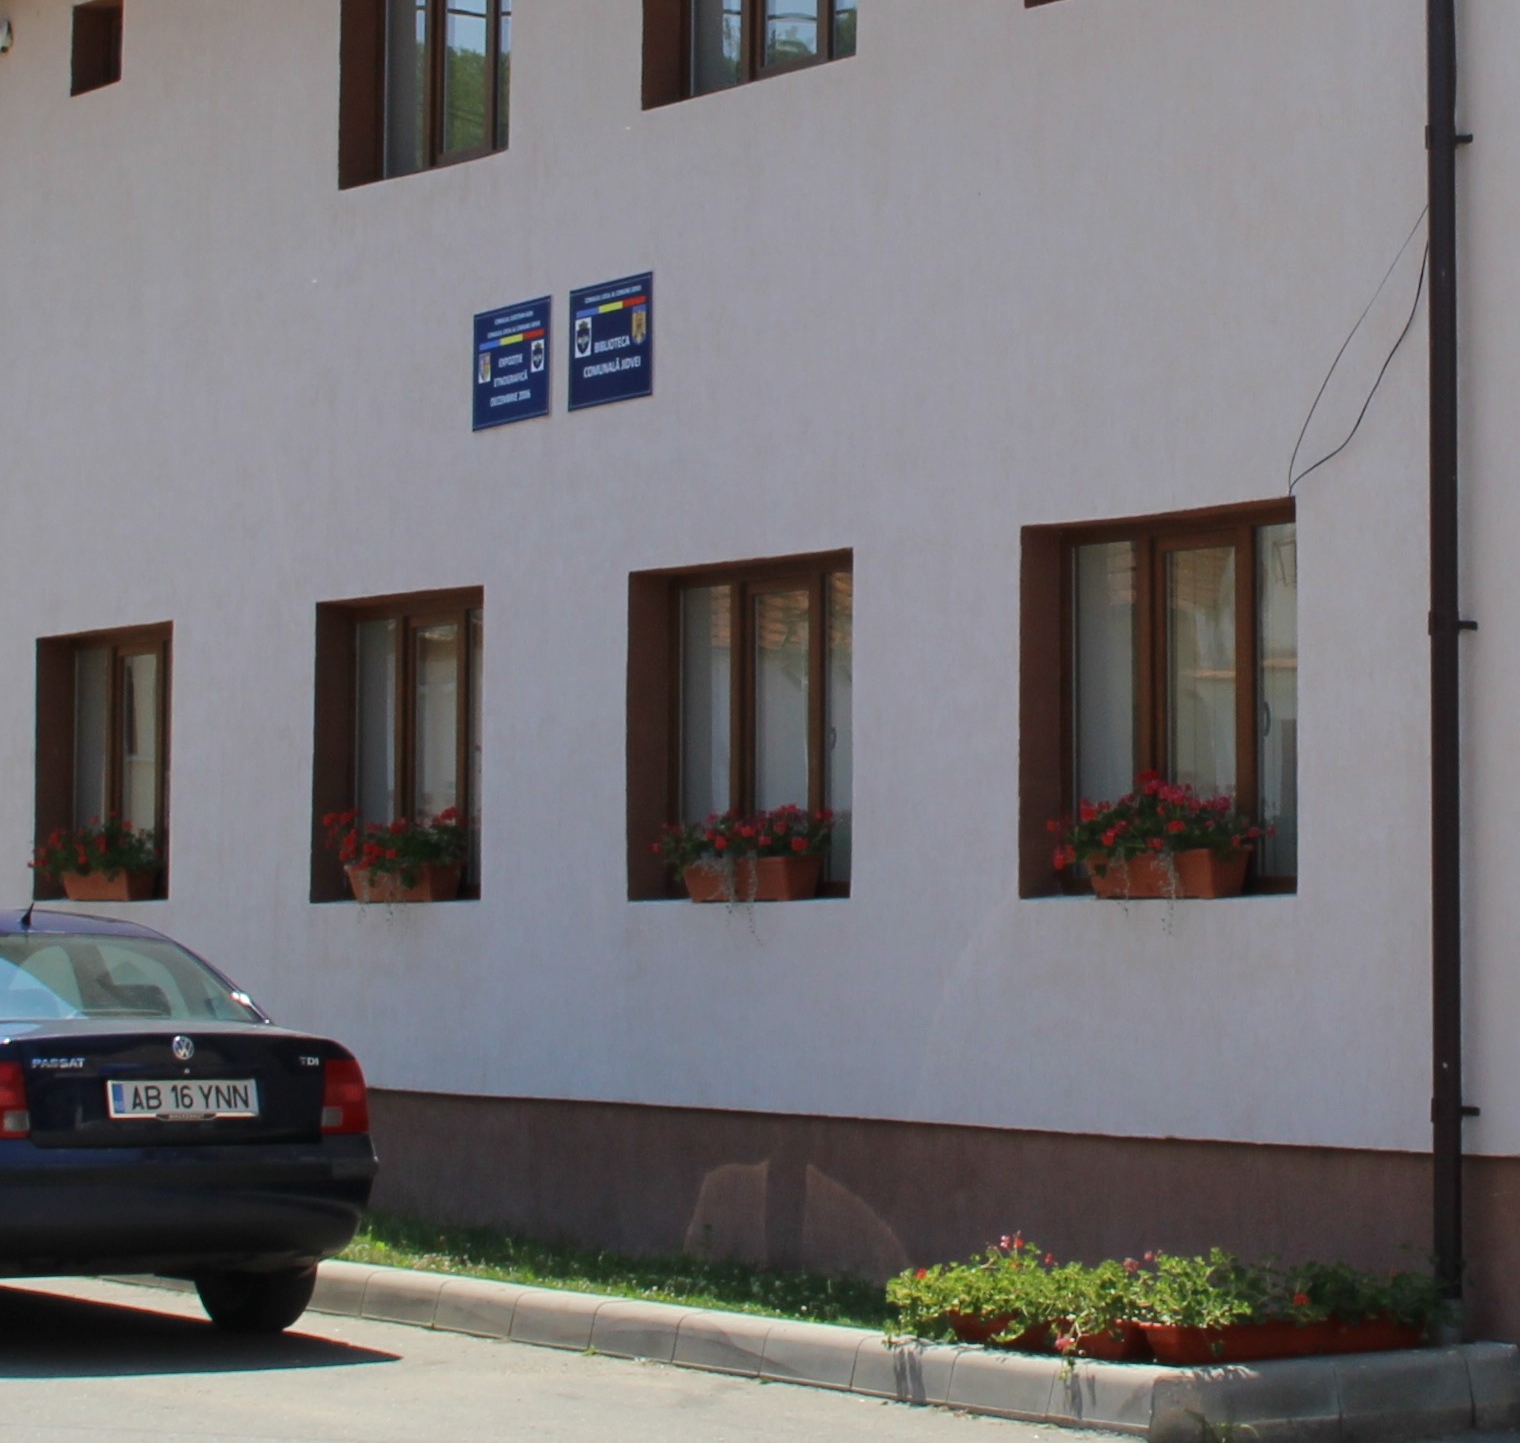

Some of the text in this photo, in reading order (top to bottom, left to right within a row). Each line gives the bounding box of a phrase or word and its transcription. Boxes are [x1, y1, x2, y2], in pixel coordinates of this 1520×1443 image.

[594, 335, 630, 353] BIBLIOTECA
[583, 357, 620, 378] COMUNALĂ
[31, 1058, 86, 1068] PASSAT
[300, 1056, 319, 1066] TDI
[132, 1084, 249, 1110] AB 16 YNN
